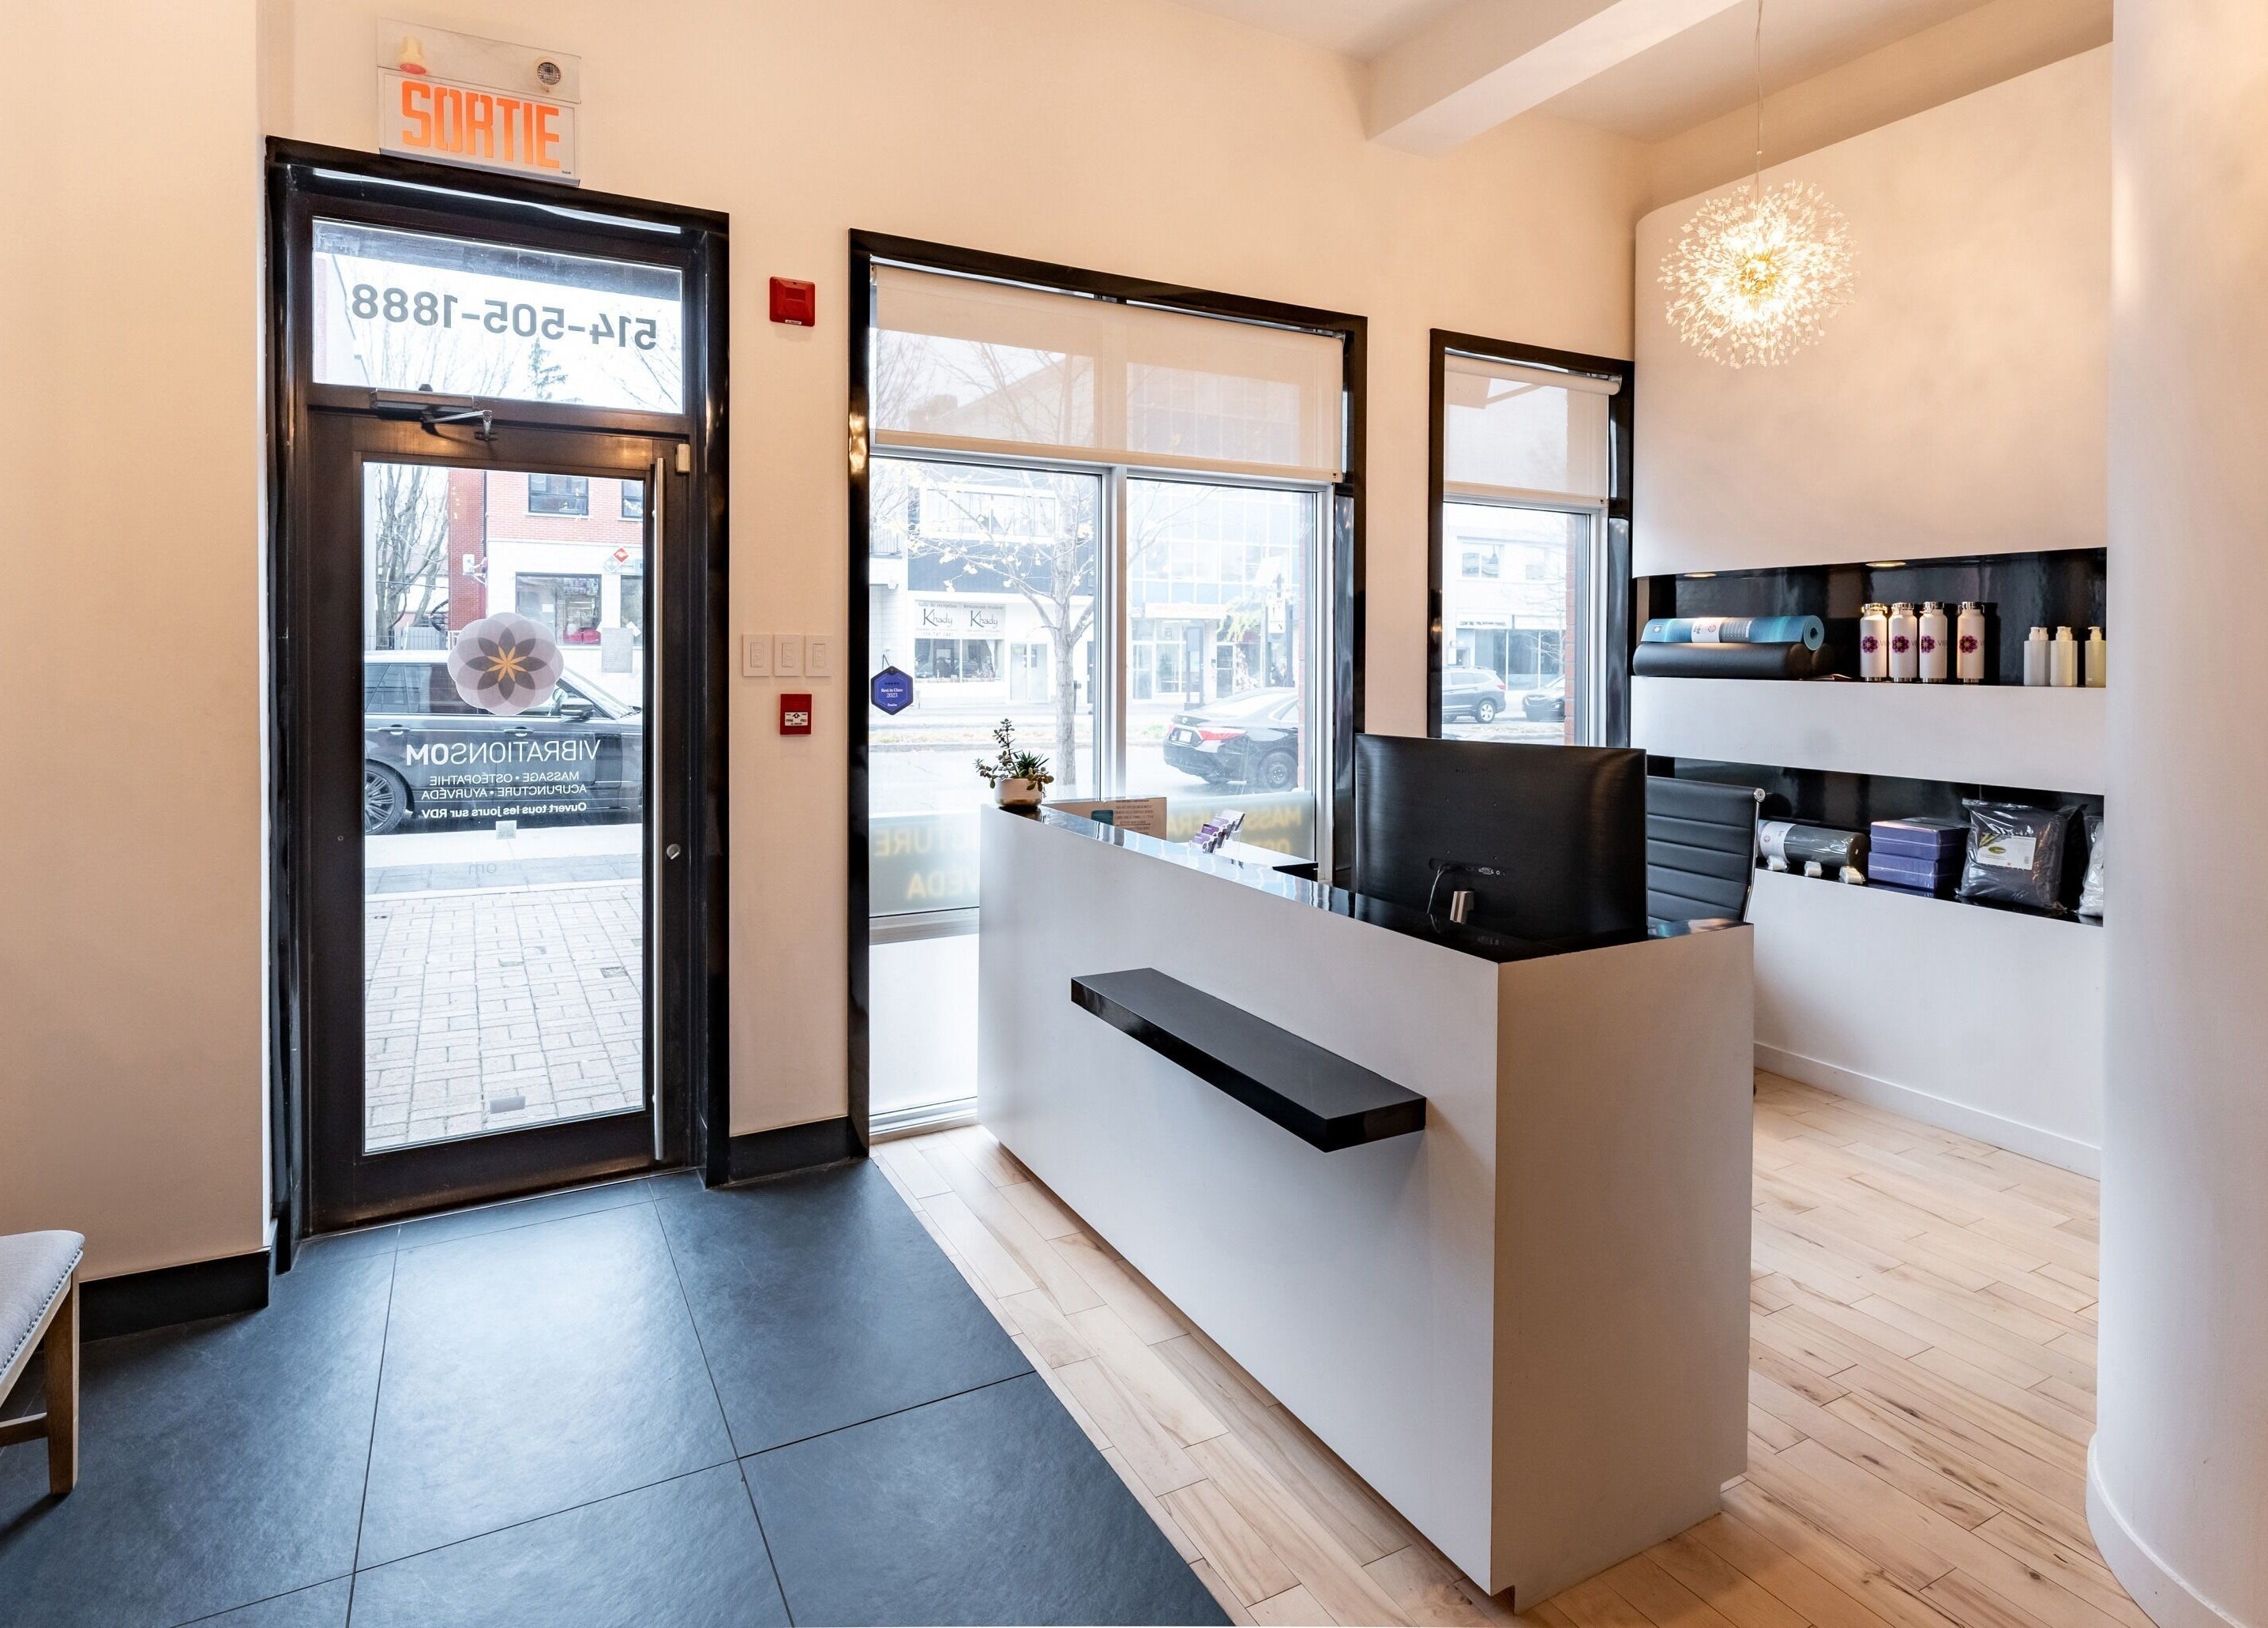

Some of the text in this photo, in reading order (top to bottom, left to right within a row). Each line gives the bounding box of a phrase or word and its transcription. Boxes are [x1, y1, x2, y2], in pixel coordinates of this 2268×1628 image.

[401, 81, 560, 169] SORTIE
[922, 608, 953, 628] Khady
[970, 610, 998, 629] Khady
